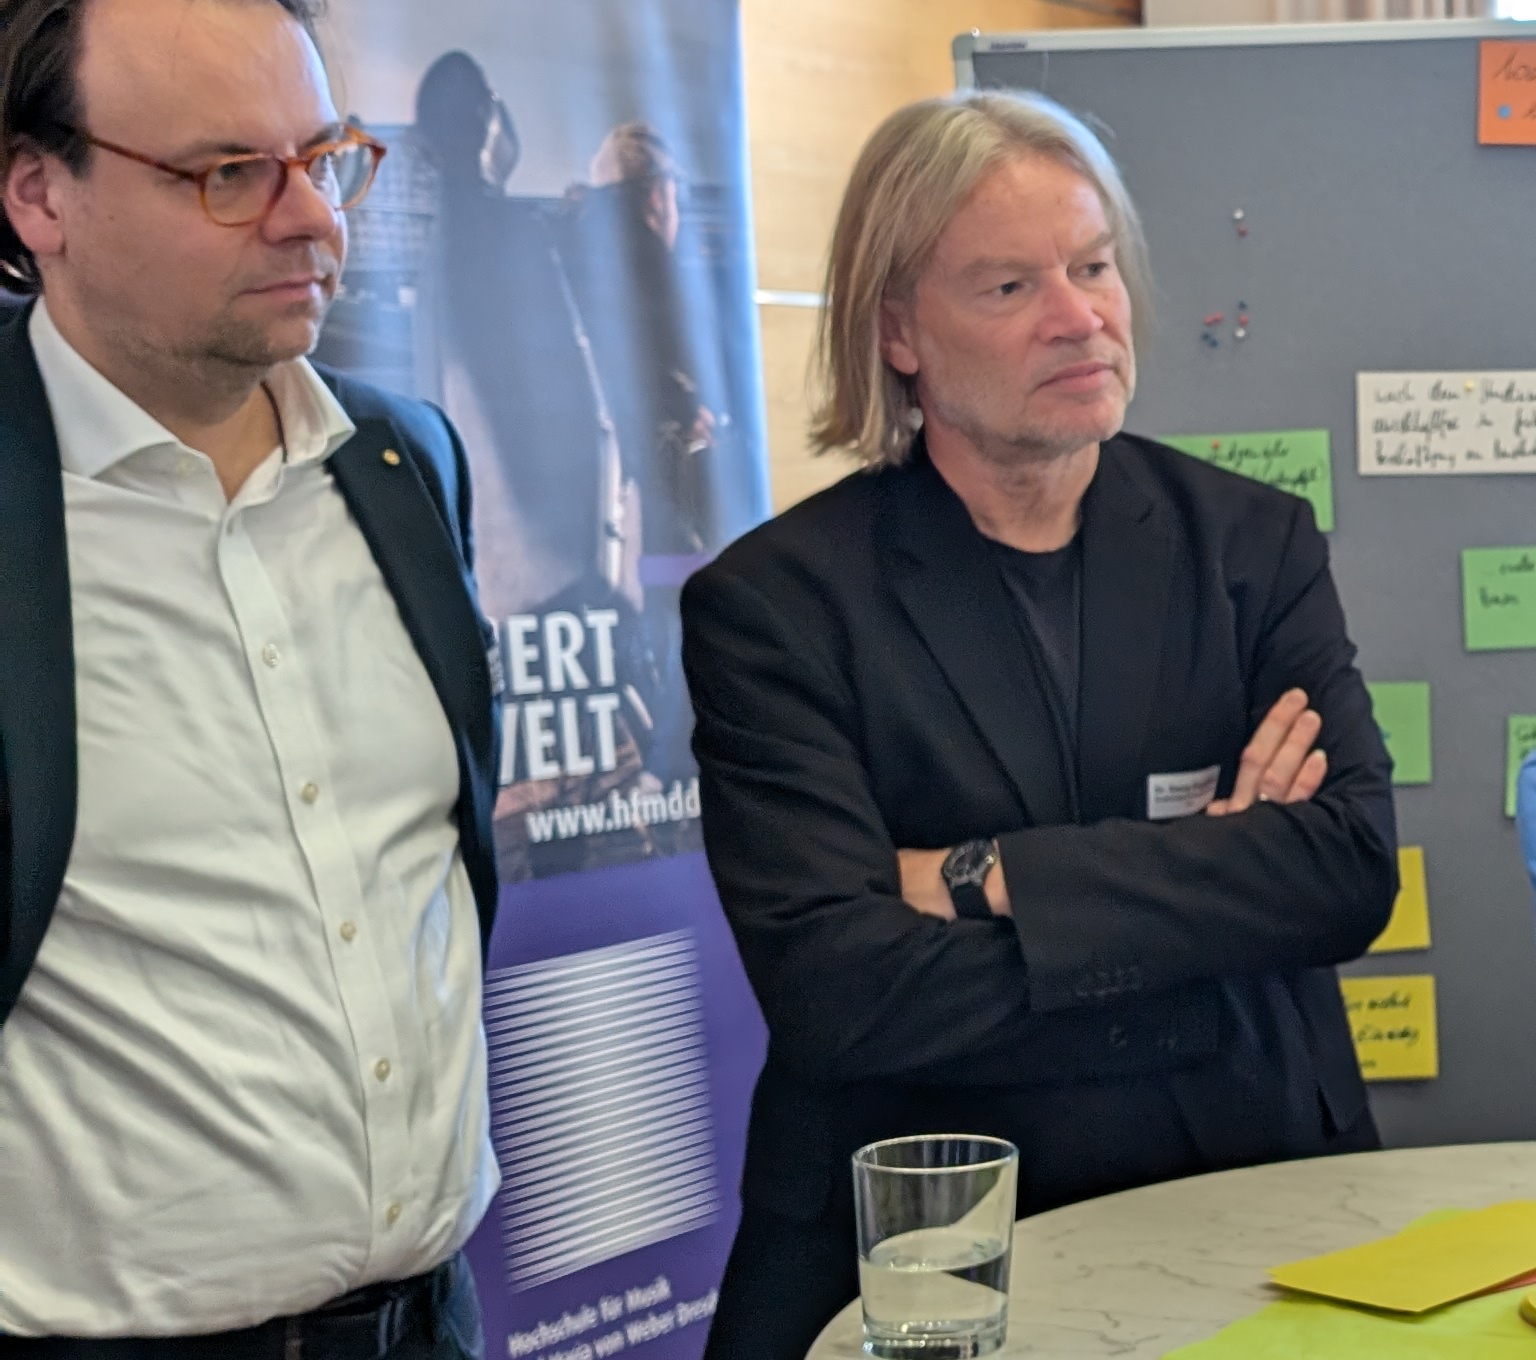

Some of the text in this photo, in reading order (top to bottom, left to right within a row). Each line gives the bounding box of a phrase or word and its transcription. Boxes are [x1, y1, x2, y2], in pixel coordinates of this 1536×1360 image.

[488, 608, 619, 695] ERT
[525, 776, 701, 843] www.hfmdd
[507, 1274, 672, 1360] Hochschule für Musik
[593, 1330, 625, 1360] von
[625, 1310, 676, 1346] Weber
[675, 1287, 719, 1328] Dresd
